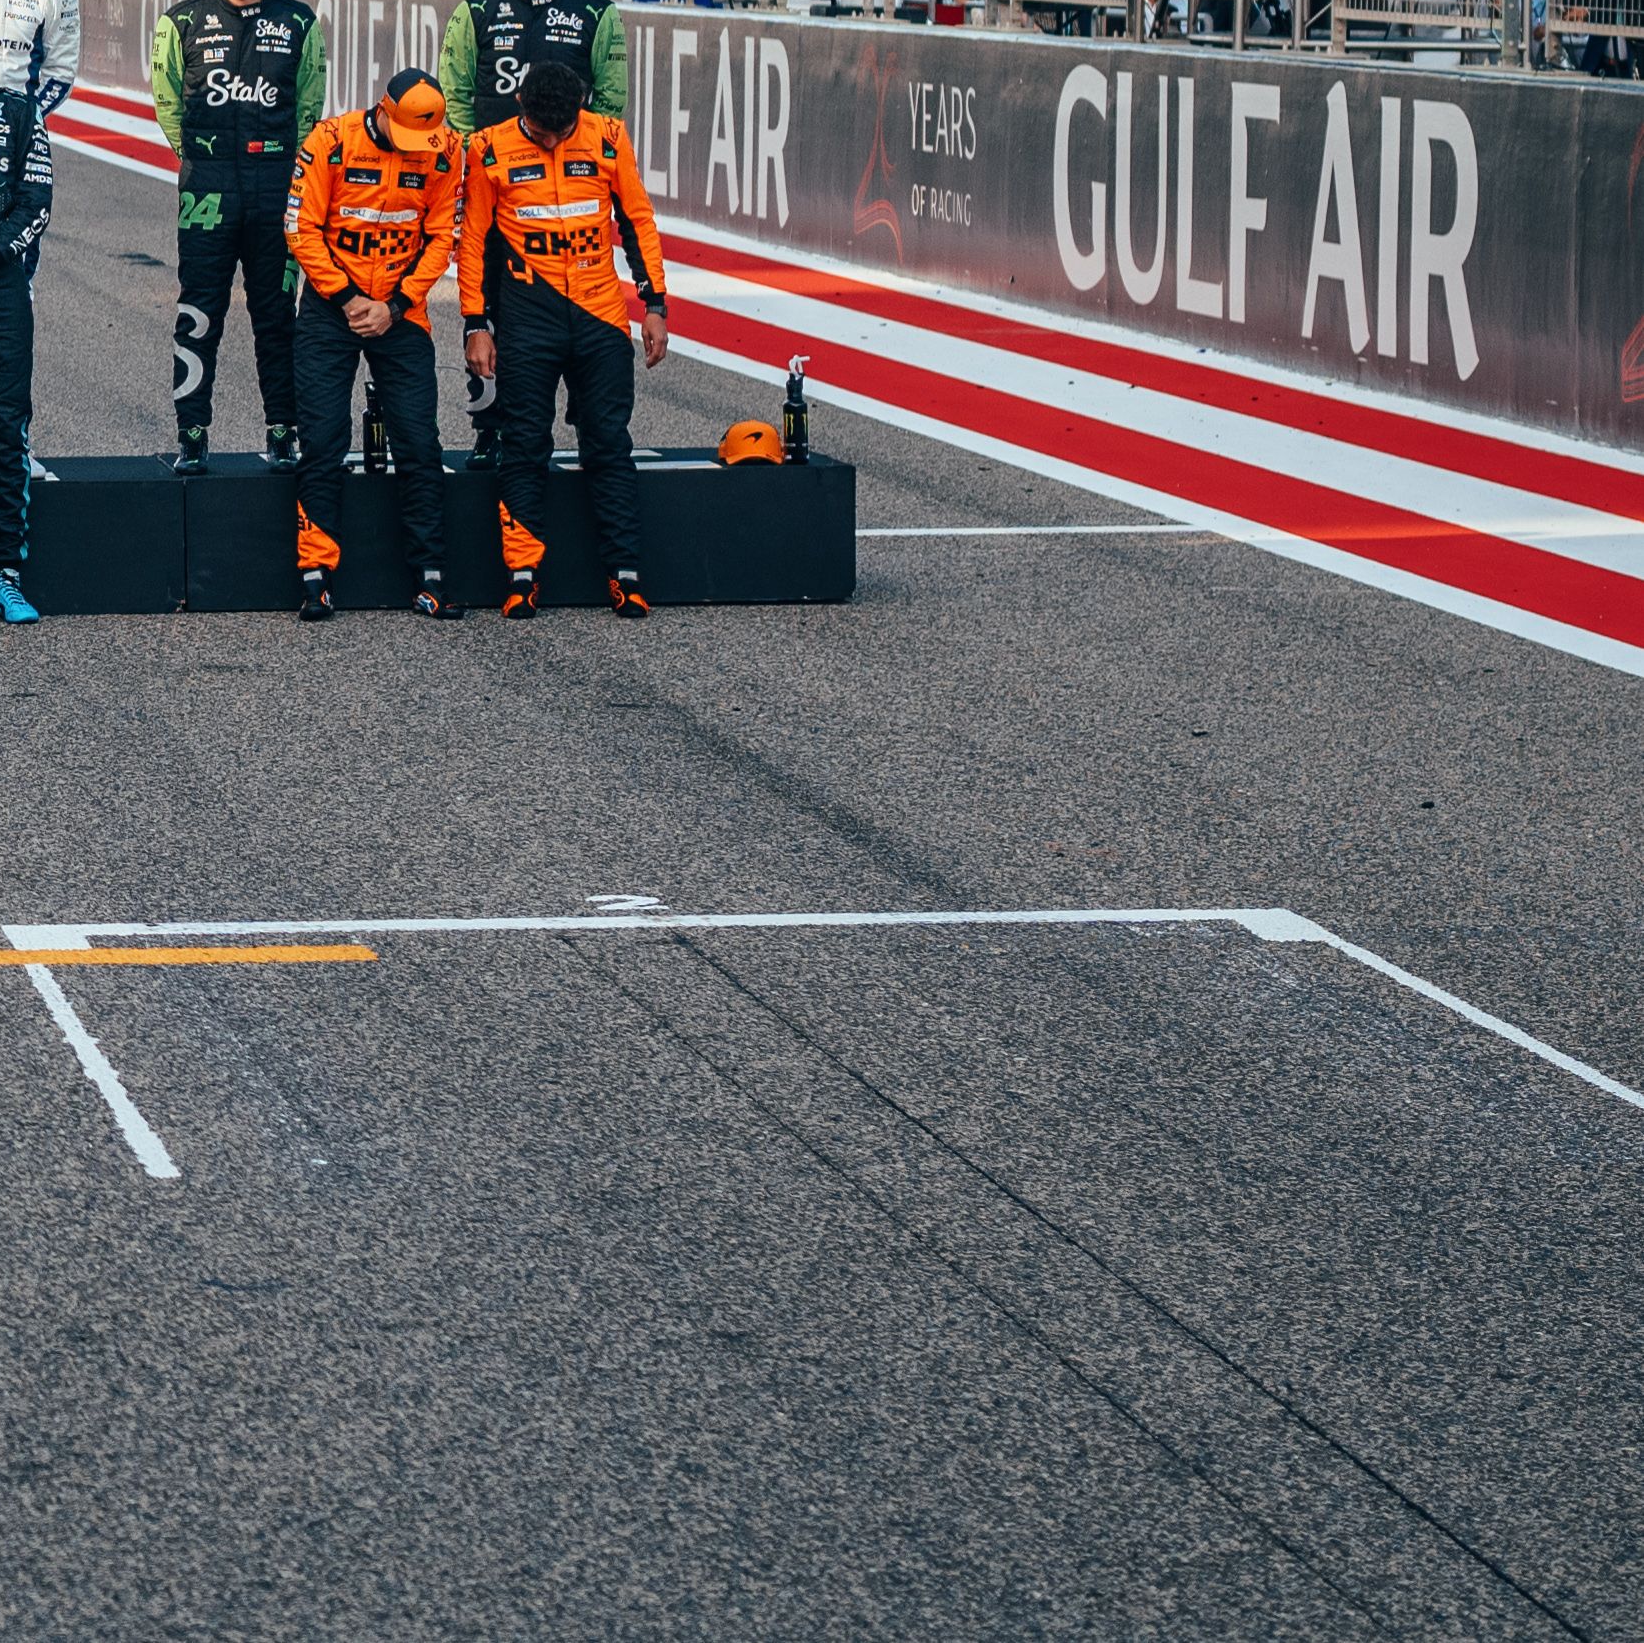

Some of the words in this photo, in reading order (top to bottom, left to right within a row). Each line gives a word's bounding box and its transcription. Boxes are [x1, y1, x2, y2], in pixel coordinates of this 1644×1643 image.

[8, 0, 35, 11] RACING
[4, 11, 38, 24] DURACELL
[255, 19, 292, 39] Stake
[546, 7, 584, 30] Stake
[207, 68, 279, 107] Stake
[705, 26, 790, 229] AIR
[909, 81, 976, 160] YEARS
[428, 133, 443, 148] 81
[508, 151, 539, 162] Android
[179, 192, 223, 230] 24
[518, 209, 542, 217] DELL
[912, 183, 926, 216] OF
[930, 187, 972, 227] RACING
[9, 208, 50, 255] INEOS
[1053, 63, 1281, 325] GULF
[1301, 80, 1480, 382] AIR
[585, 894, 670, 911] 2
